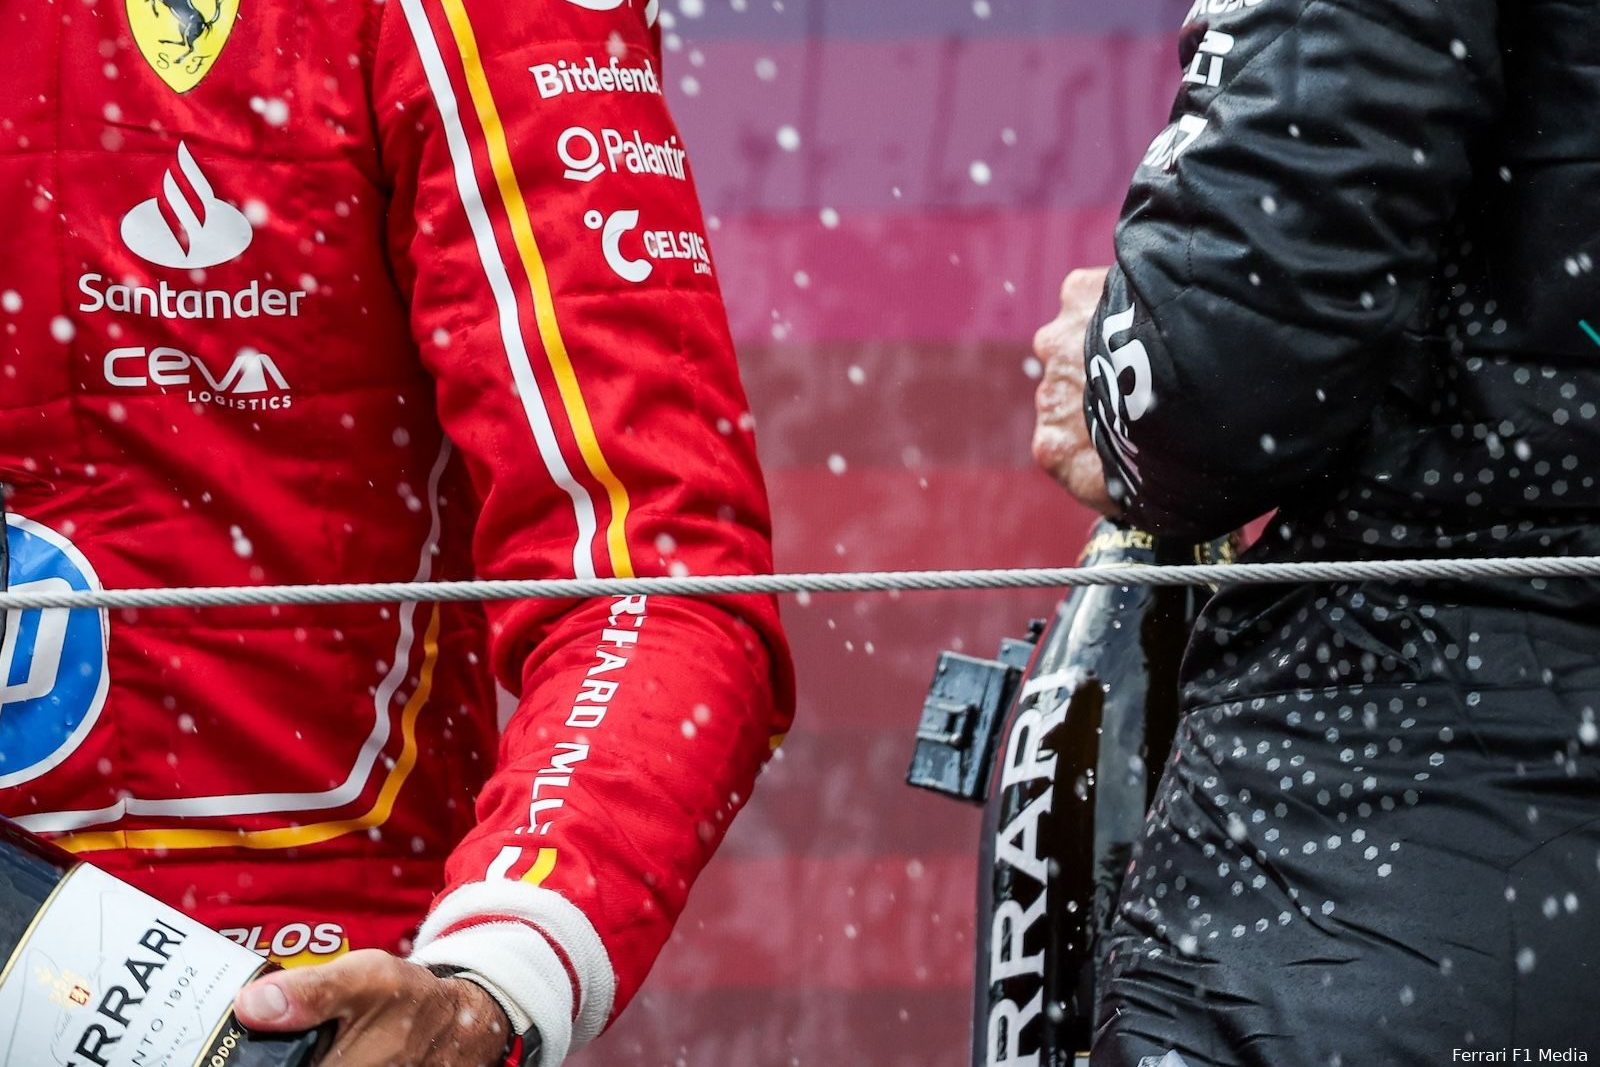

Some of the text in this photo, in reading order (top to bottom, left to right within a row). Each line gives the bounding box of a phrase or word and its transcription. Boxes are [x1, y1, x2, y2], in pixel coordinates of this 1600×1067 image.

[528, 56, 663, 100] Bitdefend
[600, 128, 687, 182] Palantir
[78, 272, 306, 320] Santander
[188, 389, 292, 411] LOGISTICS
